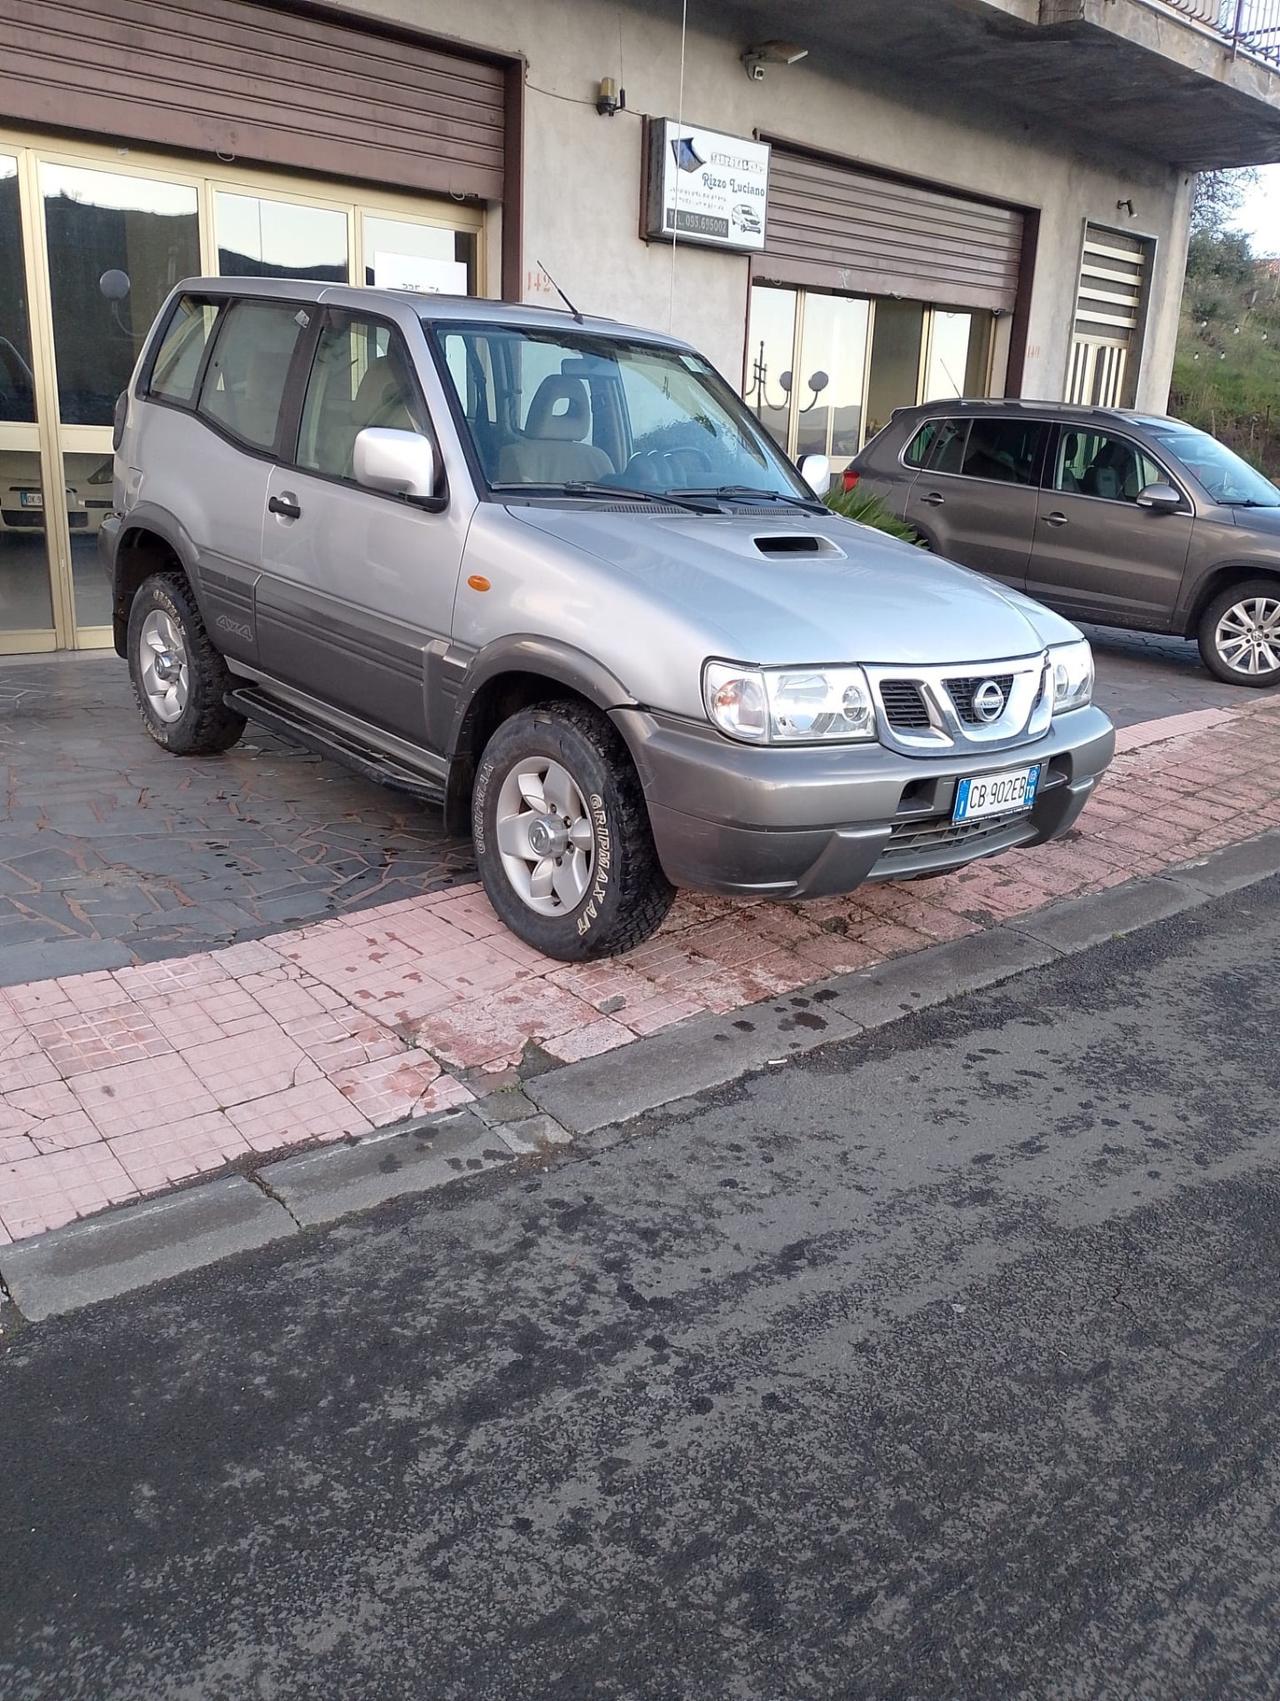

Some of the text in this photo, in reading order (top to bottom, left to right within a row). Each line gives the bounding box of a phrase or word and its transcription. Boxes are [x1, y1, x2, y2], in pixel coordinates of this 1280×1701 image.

[702, 173, 726, 190] Rizzo
[730, 179, 765, 196] Luciano
[668, 210, 684, 226] TL.
[970, 785, 987, 808] CB
[989, 777, 1026, 804] 902EB
[590, 793, 610, 904] GRIPMAX
